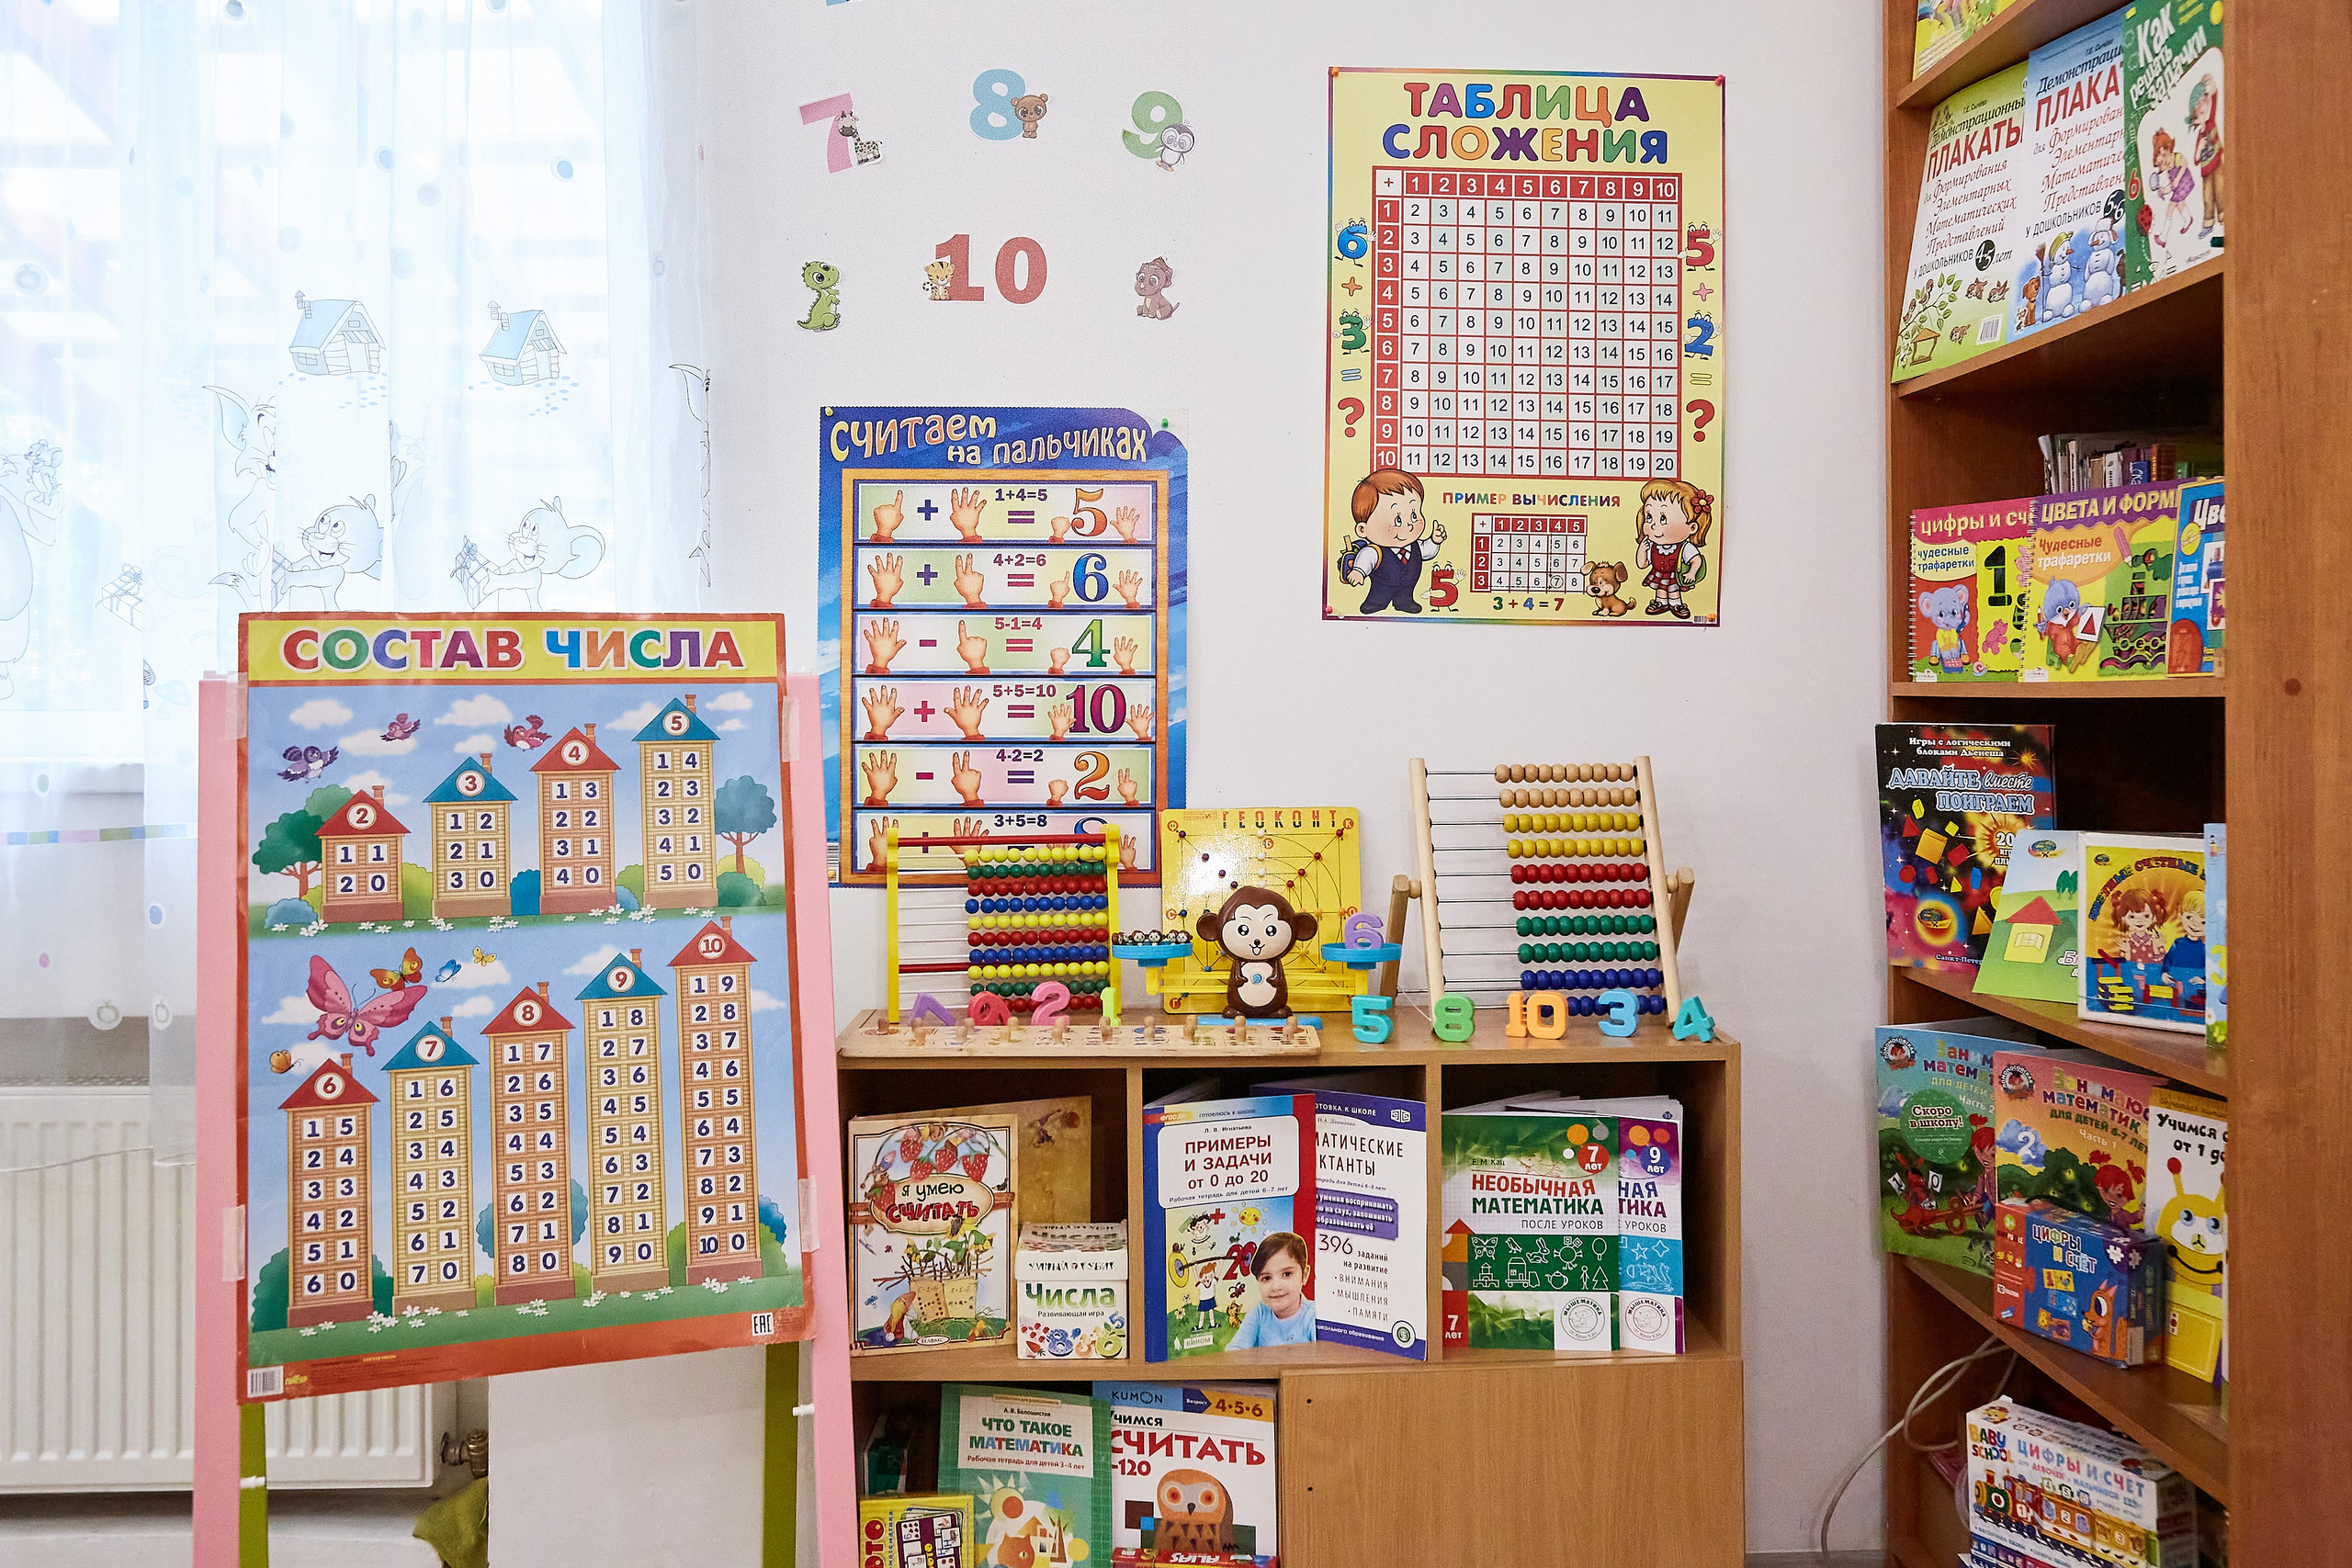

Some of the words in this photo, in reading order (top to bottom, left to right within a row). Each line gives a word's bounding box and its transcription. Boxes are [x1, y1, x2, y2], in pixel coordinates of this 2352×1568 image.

[2137, 3, 2176, 68] Как
[2130, 46, 2173, 109] решать
[2148, 25, 2207, 110] задачки
[970, 69, 1026, 141] 8
[1404, 83, 1649, 128] ТАБЛИЦА
[1123, 90, 1183, 159] 9
[1383, 123, 1668, 164] СЛОЖЕНИЯ
[1410, 177, 1418, 191] 1
[1440, 177, 1449, 192] 2
[1467, 178, 1476, 192] 3
[1495, 179, 1505, 193] 4
[1523, 180, 1532, 194] 5
[1551, 180, 1560, 194] 6
[1579, 181, 1589, 195] 7
[1606, 182, 1615, 196] 8
[1634, 182, 1643, 197] 9
[1657, 183, 1674, 197] 10
[1933, 159, 2007, 203] Формирования
[1934, 178, 2011, 216] Элементарных
[1926, 196, 2017, 238] Математических
[2033, 200, 2101, 238] ДОШКОЛЬНИКОВ
[1927, 217, 2006, 256] Представлений
[935, 234, 1047, 304] 10
[1918, 249, 1973, 277] ДОШКОЛЬНИКОВ
[1994, 250, 2013, 265] лет
[947, 445, 980, 465] на
[994, 488, 1047, 502] 1+4=5
[1442, 492, 1507, 505] ПРИМЕР
[1512, 494, 1620, 508] ВЫЧИСЛЕНИЯ
[1070, 488, 1108, 536] 5
[2041, 501, 2099, 525] ЦВЕТА
[2103, 496, 2116, 513] И
[1921, 513, 1984, 536] цифры
[1990, 513, 2001, 528] и
[1917, 546, 1969, 561] чудесные
[2038, 536, 2102, 554] Чудесные
[992, 553, 1046, 567] 4+2=6
[1917, 558, 1974, 573] трафаретки
[2036, 550, 2111, 569] трафаретки
[1073, 553, 1108, 602] 6
[1493, 597, 1503, 610] 3
[1523, 598, 1533, 610] 4
[1554, 598, 1564, 611] 7
[994, 617, 1042, 630] 5-1=4
[283, 629, 523, 671] СОСТАВ
[546, 629, 742, 670] ЧИСЛА
[1072, 619, 1110, 667] 4
[992, 684, 1057, 698] 5+5=10
[1065, 683, 1126, 734] 10
[672, 716, 682, 730] 5
[1909, 738, 1936, 746] Игры
[569, 746, 582, 761] 4
[996, 749, 1044, 762] 4-2=2
[1961, 749, 2004, 757] Дьенеша
[465, 775, 477, 791] 3
[1074, 750, 1110, 800] 2
[1890, 765, 1979, 790] ДАВАЙТЕ
[1984, 771, 2032, 790] вместе
[1937, 792, 2034, 814] ПОИГРАЕМ
[356, 808, 368, 824] 2
[994, 814, 1047, 827] 3+5=8
[702, 937, 722, 953] 10
[616, 972, 627, 987] 9
[522, 1005, 534, 1021] 8
[1031, 980, 1070, 1026] 2
[1100, 987, 1121, 1026] 1
[1599, 988, 1639, 1037] 3
[1351, 995, 1393, 1043] 5
[1433, 993, 1475, 1043] 8
[1506, 991, 1567, 1039] 10
[1672, 996, 1715, 1043] 4
[425, 1041, 437, 1056] 7
[323, 1077, 336, 1094] 6
[1351, 1108, 1376, 1116] ШКОЛЕ
[1913, 1106, 1951, 1116] Скоро
[1959, 1095, 1985, 1110] Часть
[1919, 1117, 1962, 1129] школу!
[2157, 1113, 2216, 1139] Учимся
[1185, 1135, 1271, 1154] ПРИМЕРЫ
[2018, 1132, 2036, 1158] 2
[2079, 1129, 2107, 1145] Часть
[2174, 1140, 2191, 1153] от
[1185, 1159, 1195, 1172] И
[1204, 1152, 1272, 1170] ЗАДАЧИ
[1588, 1145, 1599, 1162] 7
[1649, 1146, 1660, 1163] 9
[1319, 1155, 1375, 1176] КТАНТЫ
[1585, 1162, 1602, 1170] лет
[1647, 1164, 1665, 1173] лет
[1188, 1179, 1204, 1190] от
[1210, 1175, 1218, 1186] 0
[1226, 1175, 1243, 1187] до
[1250, 1170, 1268, 1183] 20
[1472, 1174, 1595, 1198] НЕОБЫЧНАЯ
[916, 1183, 964, 1201] умею
[886, 1201, 979, 1223] СЧИТАТЬ
[1472, 1198, 1603, 1214] МАТЕМАТИКА
[1521, 1220, 1556, 1229] ПОСЛЕ
[1562, 1220, 1603, 1230] УРОКОВ
[1625, 1221, 1667, 1233] УРОКОВ
[1319, 1234, 1352, 1255] 396
[1358, 1250, 1388, 1261] заданий
[2032, 1224, 2081, 1251] ЦИФРЫ
[1354, 1263, 1388, 1274] развитие
[2065, 1252, 2097, 1273] СЧЁТ
[1340, 1274, 1388, 1290] ВНИМАНИЯ
[1026, 1283, 1116, 1308] Числа
[1338, 1289, 1388, 1305] МЫШЛЕНИЯ
[1353, 1307, 1388, 1322] ПАМЯТИ
[1448, 1315, 1458, 1330] 7
[1047, 1328, 1073, 1357] 8
[1445, 1331, 1462, 1339] лет
[1112, 1391, 1162, 1404] KUMON
[982, 1417, 1014, 1431] ЧТО
[1020, 1420, 1071, 1437] ТАКОЕ
[1969, 1424, 2007, 1448] BABY
[969, 1436, 1083, 1457] МАТЕМАТИКА
[1112, 1430, 1265, 1465] СЧИТАТЬ
[1973, 1445, 2013, 1462] SCHOOL
[2018, 1439, 2080, 1474] ЦИФРЫ
[2086, 1463, 2098, 1481] И
[2103, 1471, 2144, 1497] СЧЕТ
